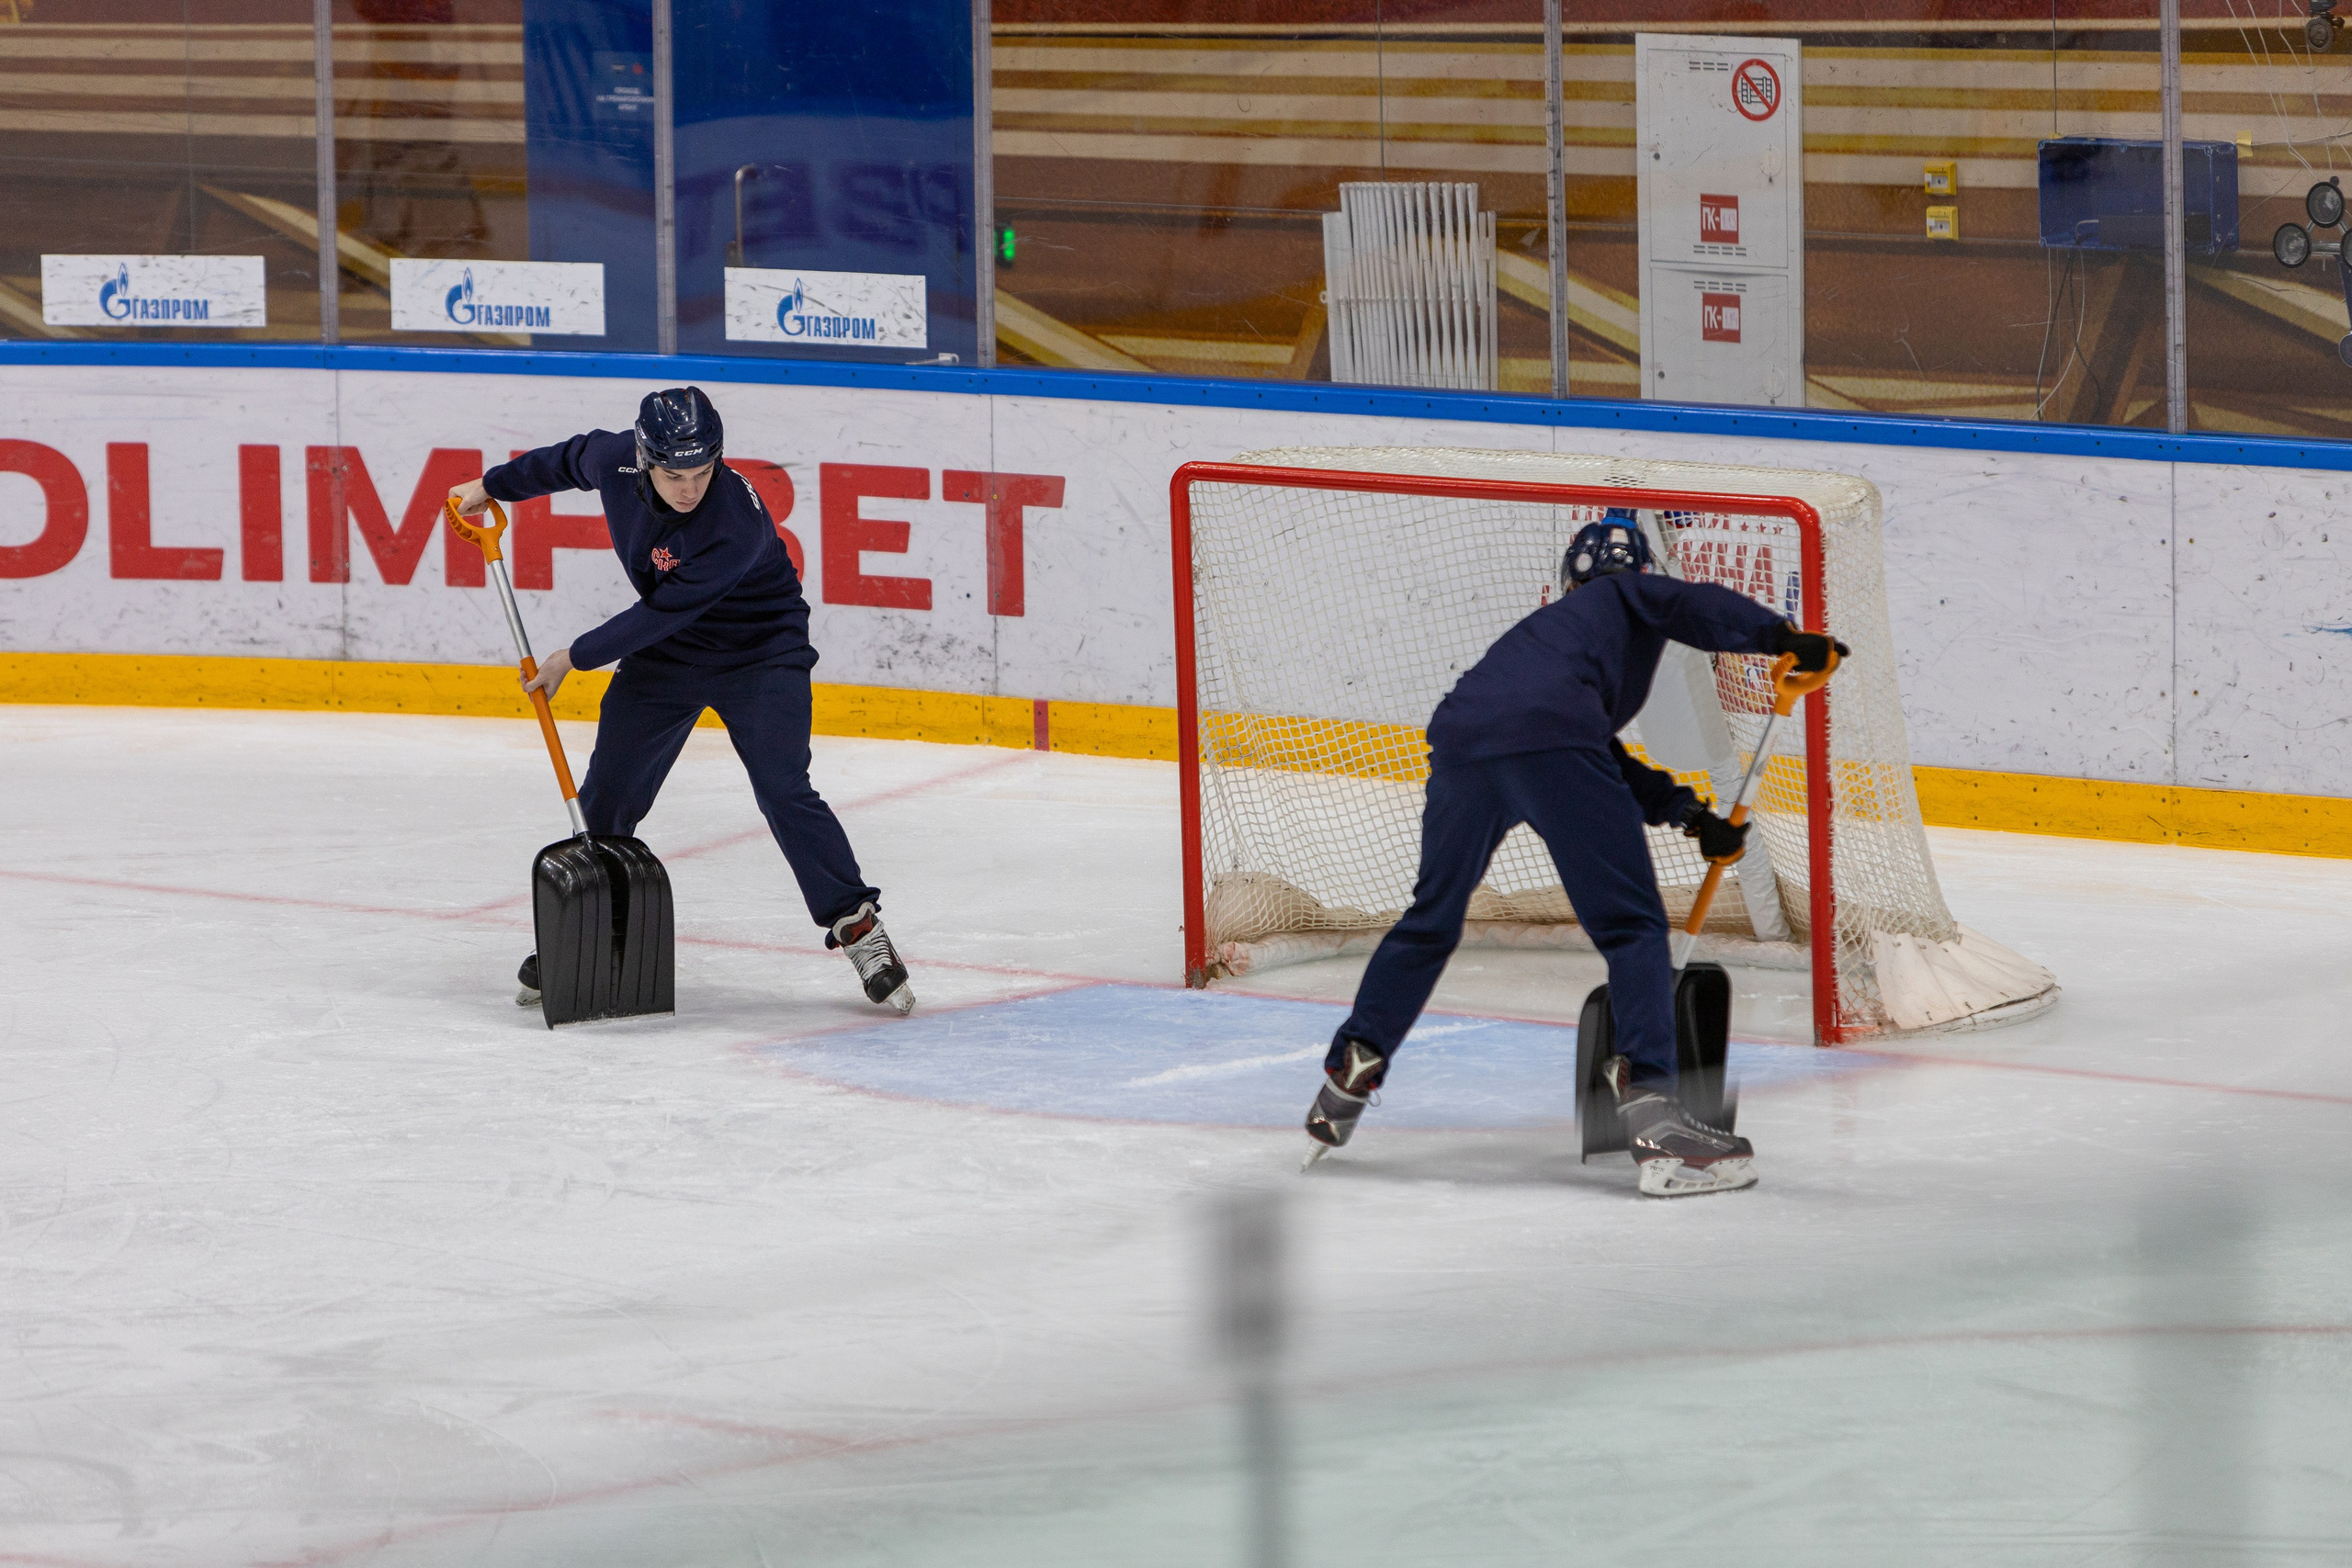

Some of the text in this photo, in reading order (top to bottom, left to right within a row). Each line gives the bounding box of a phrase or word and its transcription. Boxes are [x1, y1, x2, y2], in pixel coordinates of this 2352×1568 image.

[132, 299, 209, 320] ГАЗПРОМ
[477, 304, 550, 327] ГАЗПРОМ
[806, 315, 876, 339] ГАЗПРОМ
[674, 447, 703, 457] CCM
